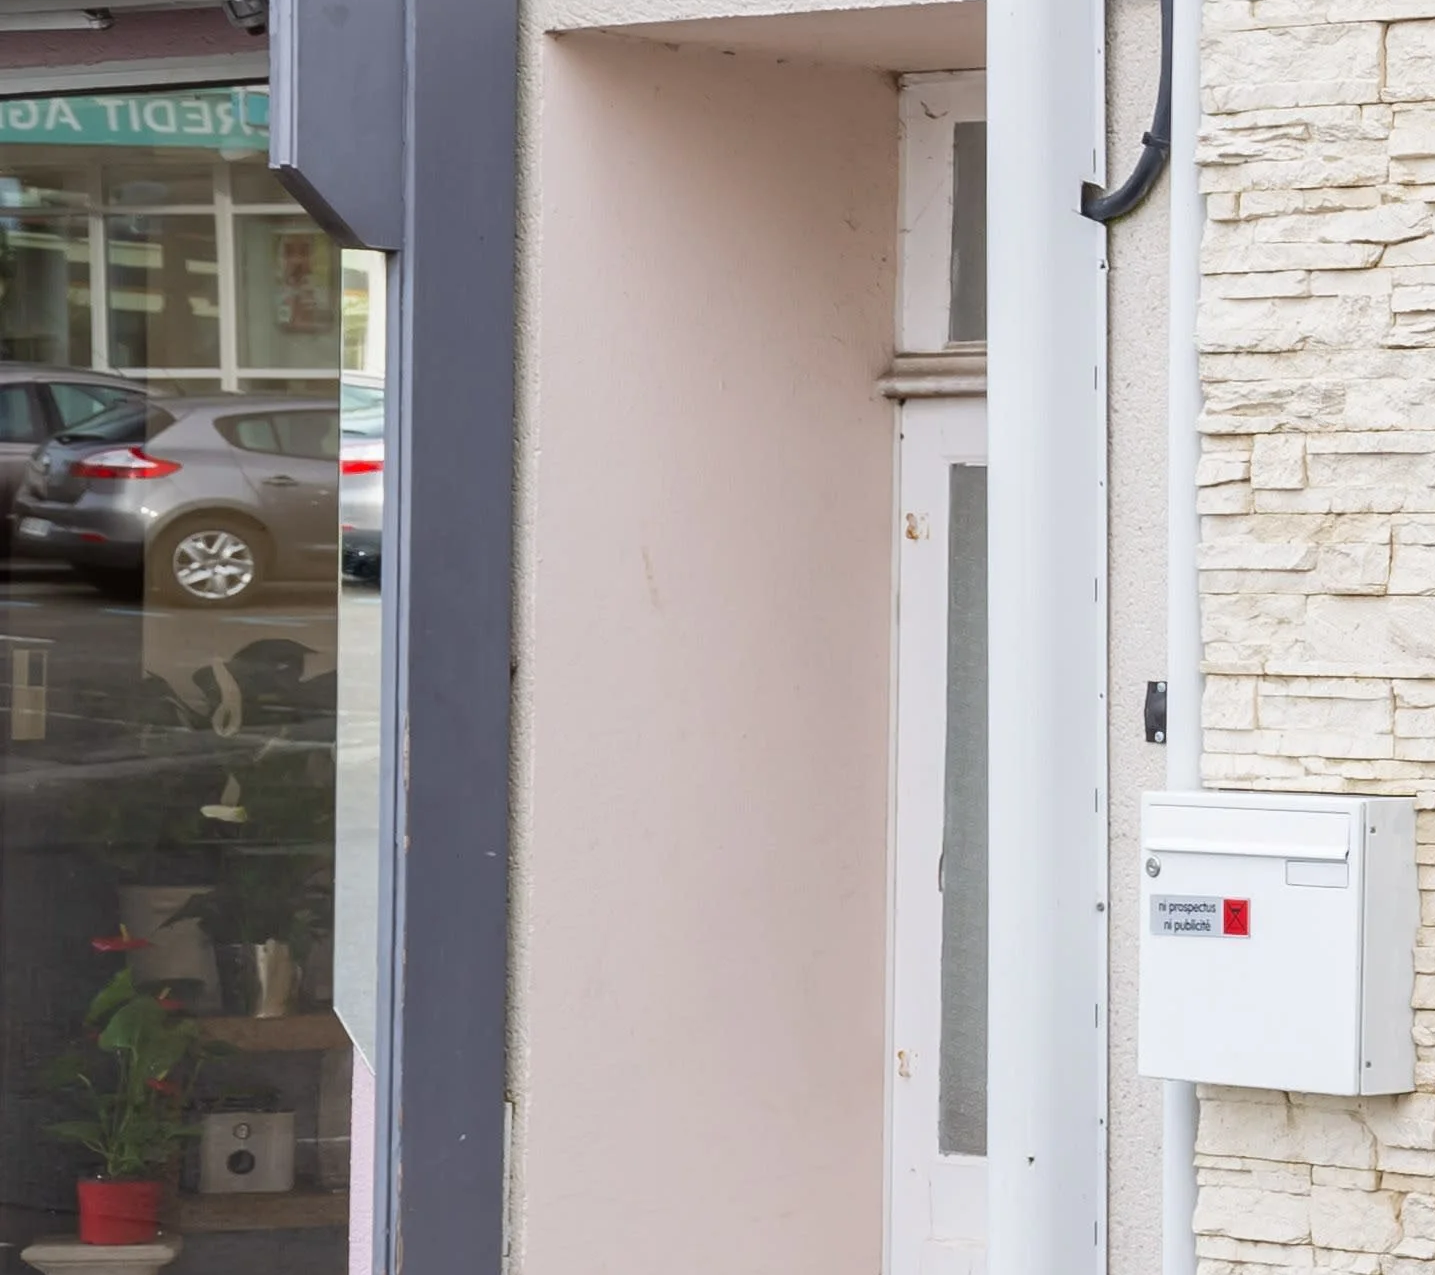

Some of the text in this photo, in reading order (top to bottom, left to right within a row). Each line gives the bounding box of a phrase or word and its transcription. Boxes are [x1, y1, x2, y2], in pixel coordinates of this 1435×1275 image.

[1158, 899, 1216, 914] ni prospectus
[1164, 918, 1211, 933] ni publicité
